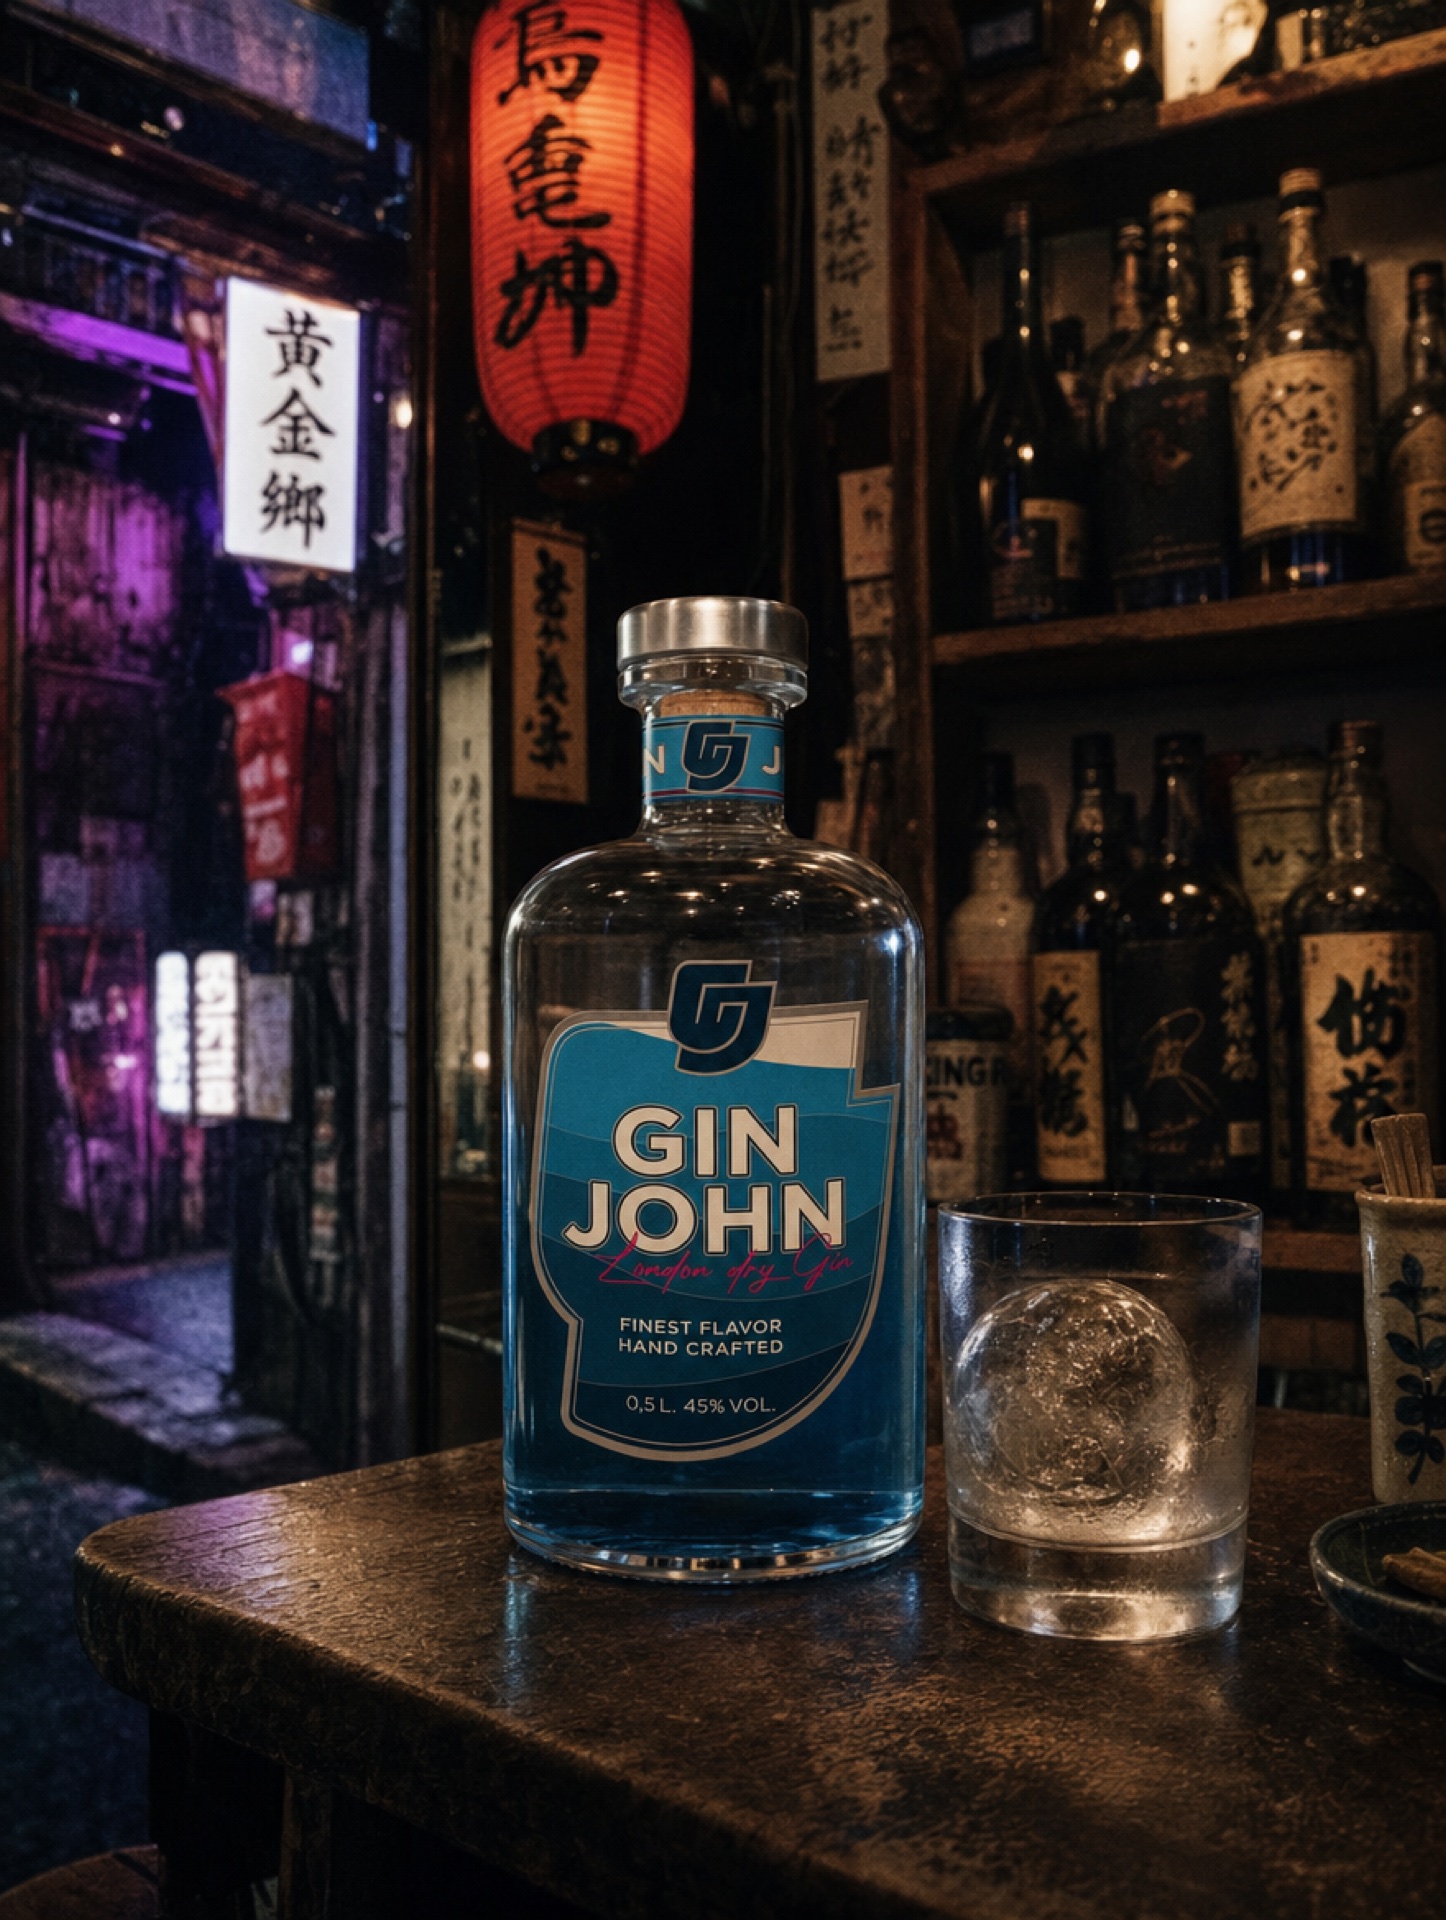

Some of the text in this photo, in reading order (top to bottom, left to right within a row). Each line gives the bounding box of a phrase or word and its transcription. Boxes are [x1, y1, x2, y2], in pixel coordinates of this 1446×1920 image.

[611, 1103, 799, 1178] GIN
[561, 1176, 847, 1256] JOHN
[594, 1231, 854, 1295] London dry Gin
[618, 1337, 784, 1357] HAND CRAFTED
[620, 1317, 782, 1336] FINEST FLAVOR
[625, 1395, 655, 1414] 0,5
[683, 1398, 725, 1415] 45%
[729, 1397, 777, 1413] VOL.
